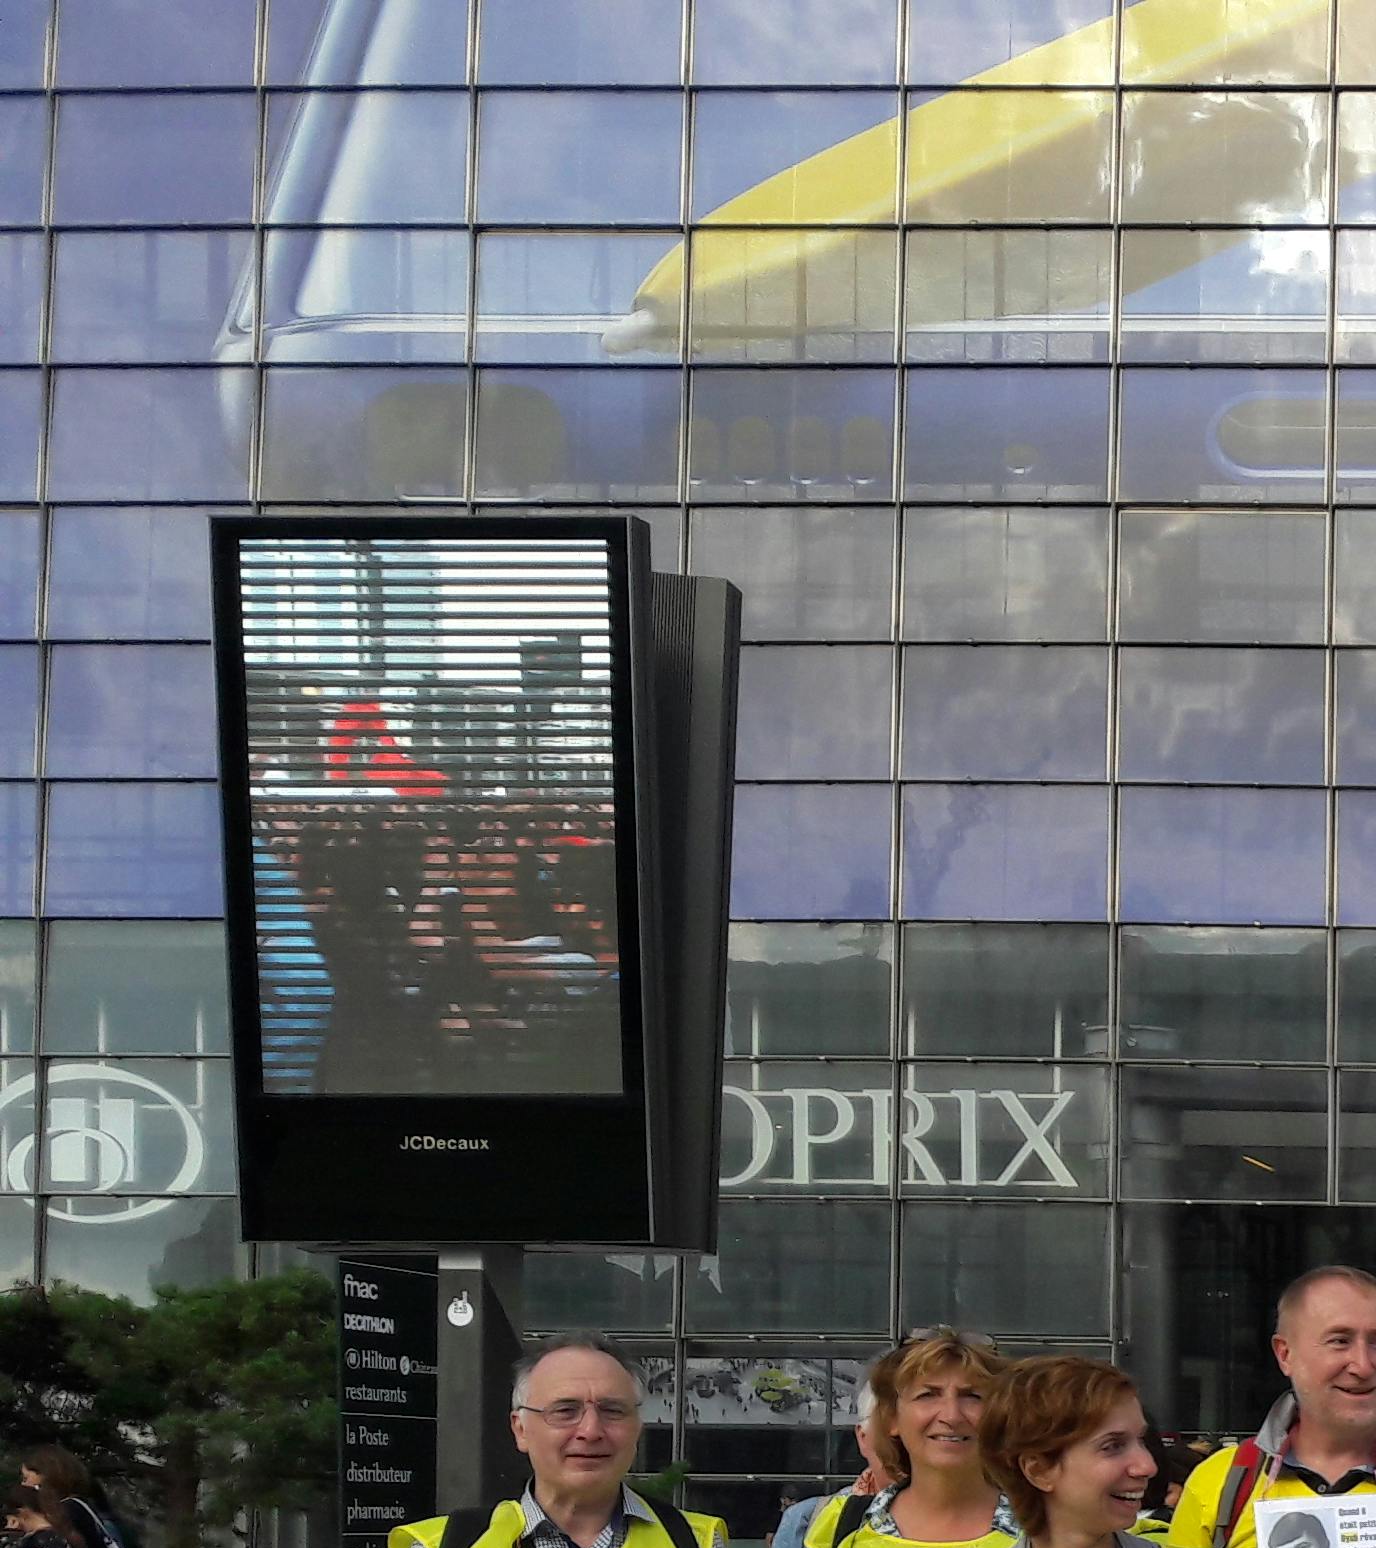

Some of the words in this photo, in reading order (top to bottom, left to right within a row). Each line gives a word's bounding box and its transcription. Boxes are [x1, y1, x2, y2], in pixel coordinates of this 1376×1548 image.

[400, 1136, 489, 1150] JCDecaux
[344, 1274, 379, 1300] fnac
[344, 1313, 395, 1335] DECATHLON
[362, 1350, 398, 1372] Hilton
[346, 1386, 408, 1404] restaurants
[346, 1424, 356, 1445] la
[358, 1426, 390, 1447] Poste
[346, 1462, 413, 1484] distributeur
[346, 1500, 406, 1525] pharmacie
